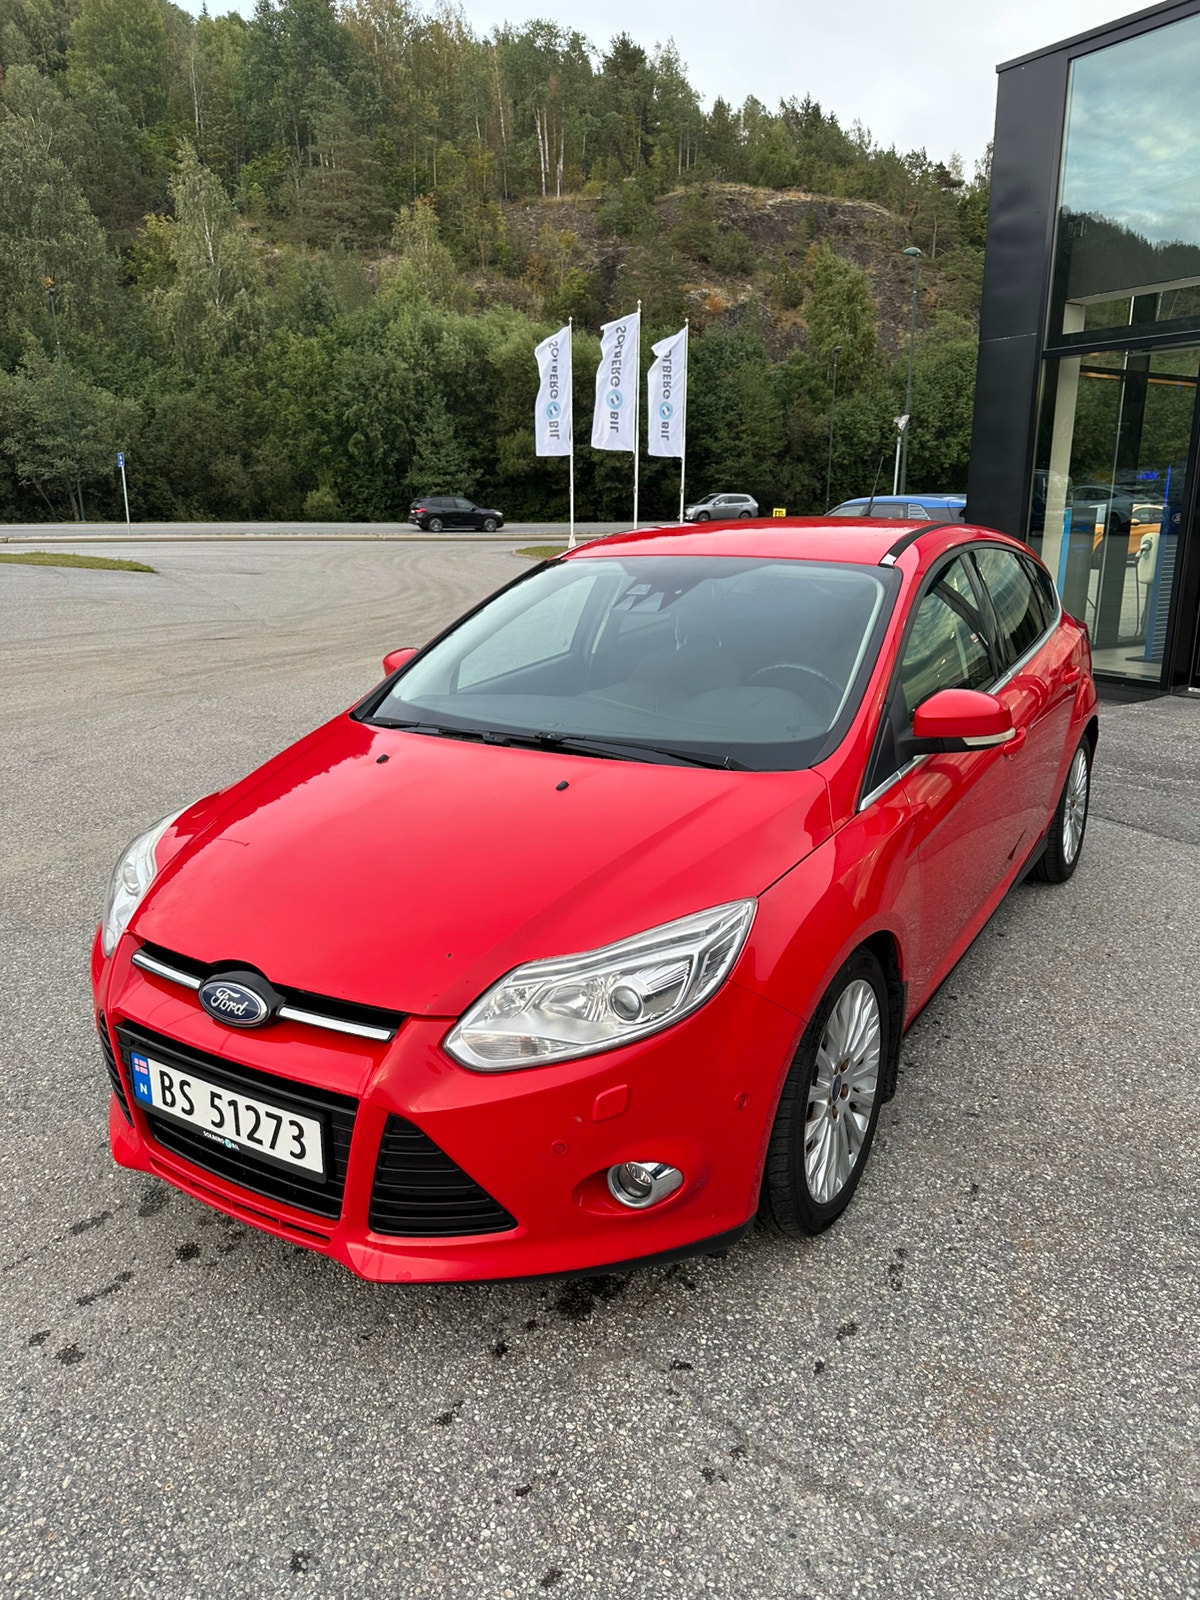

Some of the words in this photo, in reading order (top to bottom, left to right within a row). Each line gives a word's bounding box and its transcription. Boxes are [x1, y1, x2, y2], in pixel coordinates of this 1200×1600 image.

[210, 987, 249, 1016] Ford
[139, 1082, 148, 1095] N
[159, 1069, 195, 1116] BS
[209, 1090, 307, 1160] 51273
